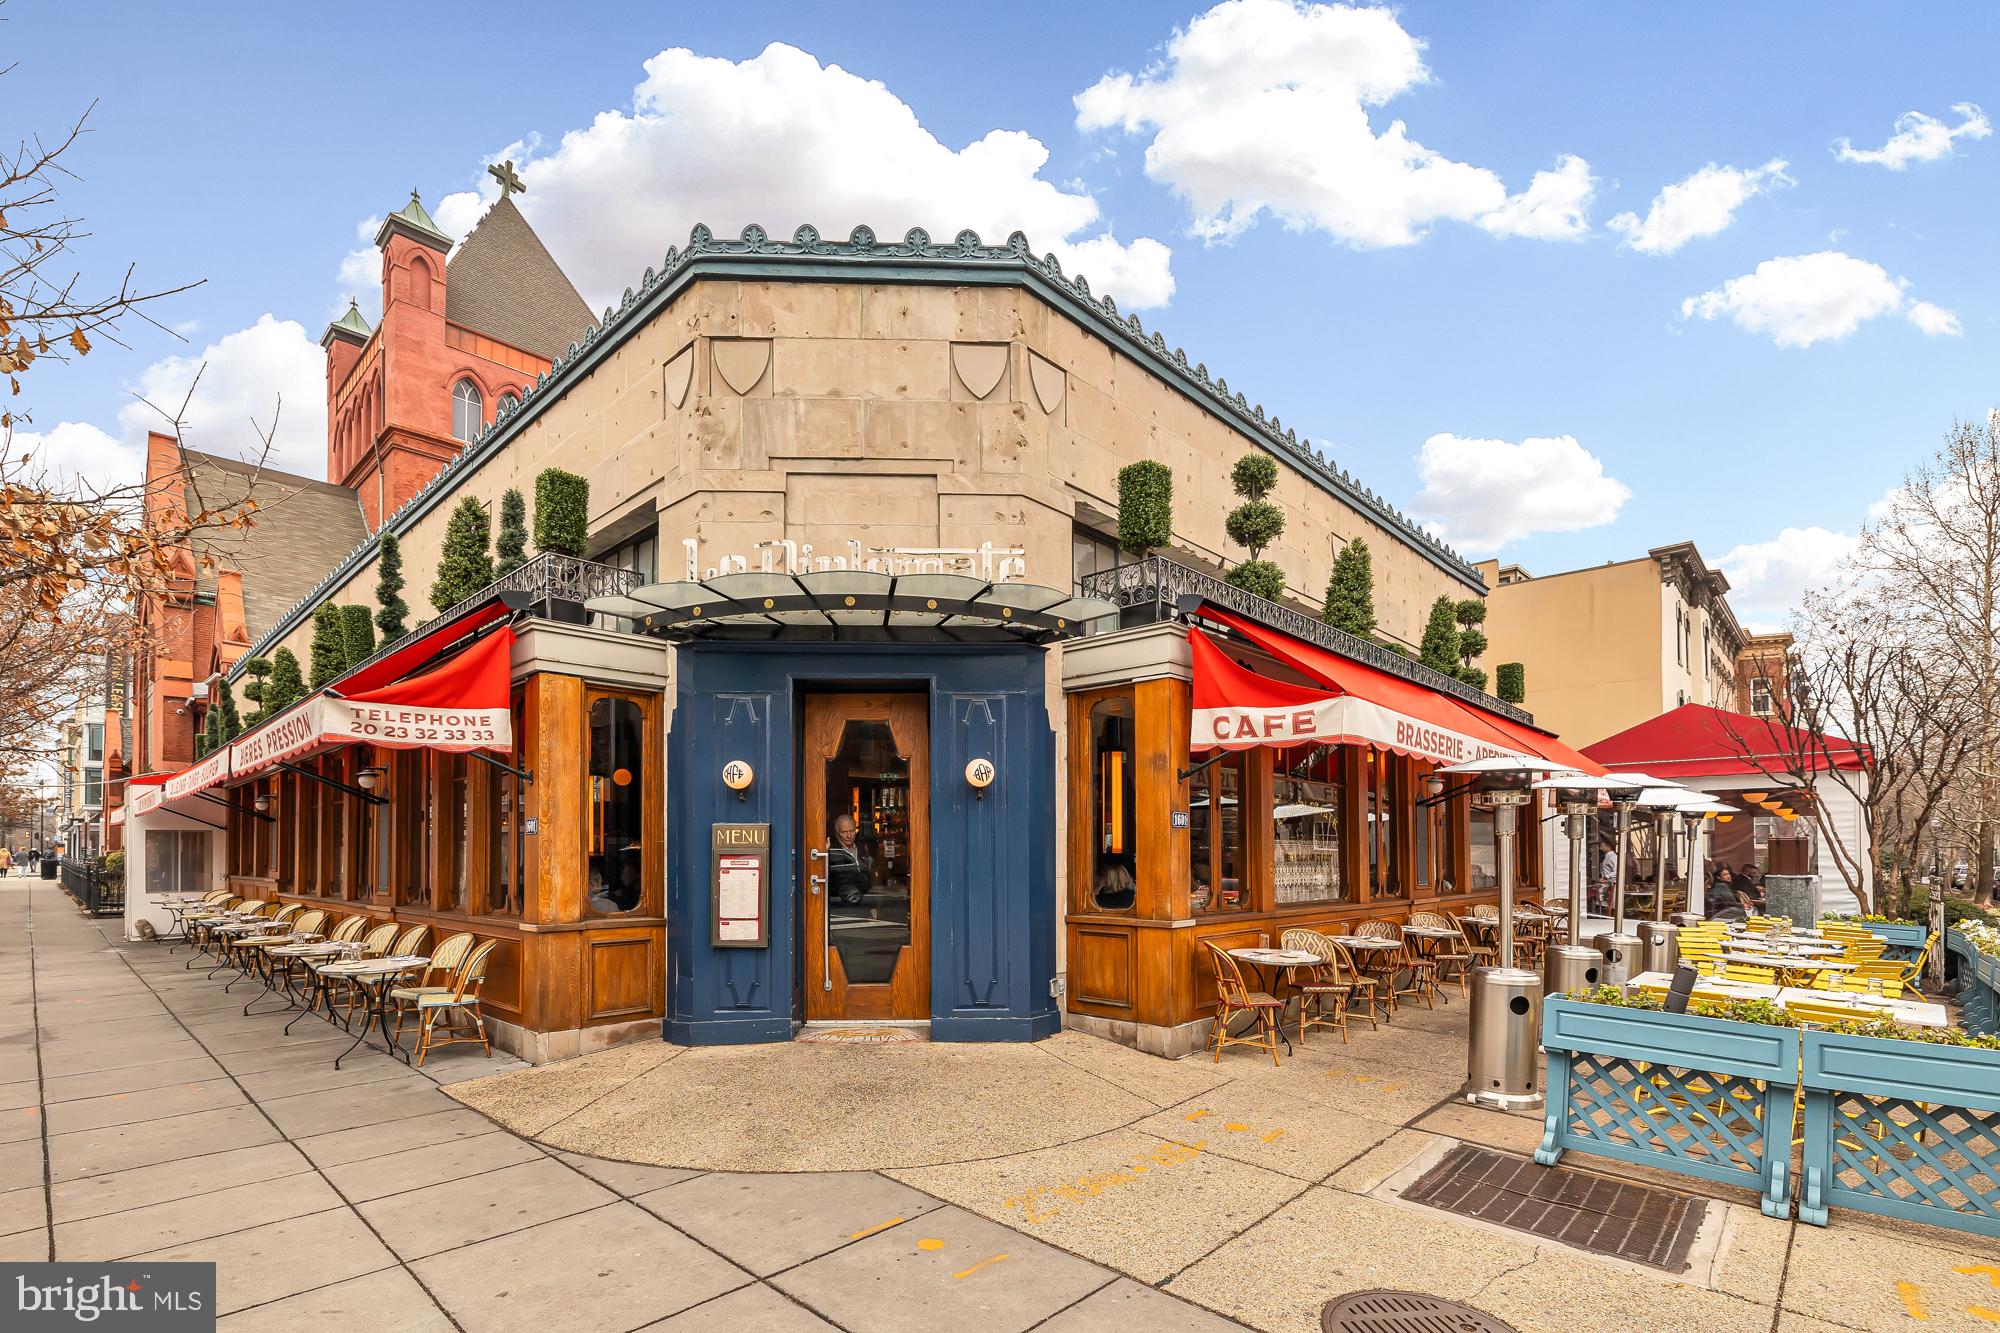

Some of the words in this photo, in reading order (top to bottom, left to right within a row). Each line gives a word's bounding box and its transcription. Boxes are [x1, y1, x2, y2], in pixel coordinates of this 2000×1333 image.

[350, 707, 492, 727] TELEPHONE
[1212, 709, 1317, 740] CAFE
[265, 712, 312, 755] PRESSION
[350, 721, 378, 735] 20
[384, 725, 409, 738] 23
[415, 728, 438, 740] 32
[444, 729, 466, 741] 33
[472, 730, 495, 741] 33
[1396, 719, 1464, 760] BRASSERIE
[716, 829, 765, 845] MENU
